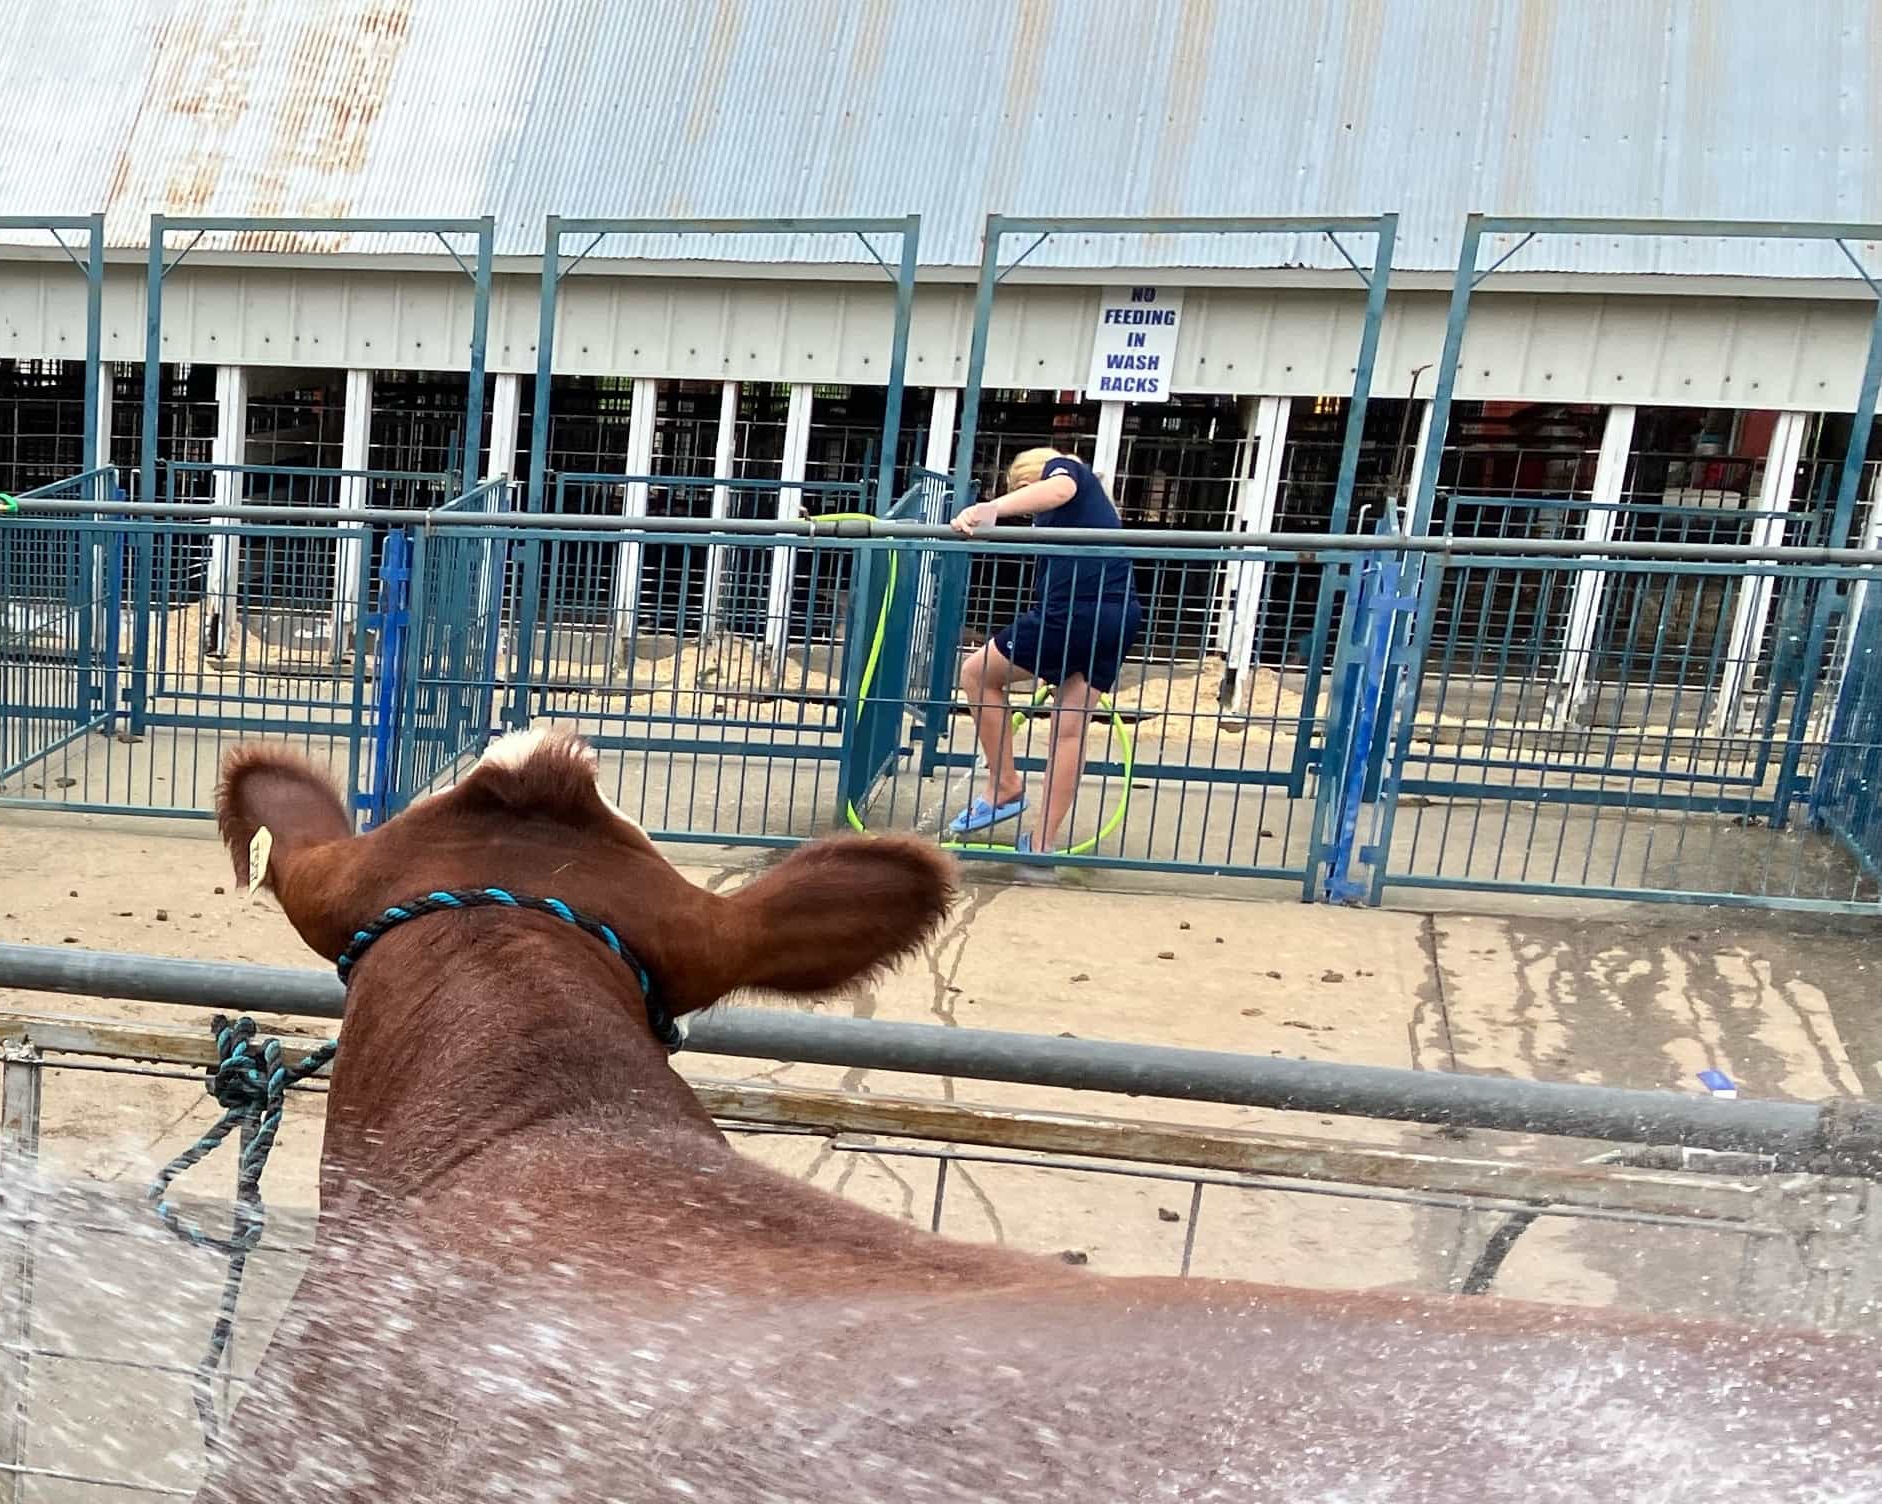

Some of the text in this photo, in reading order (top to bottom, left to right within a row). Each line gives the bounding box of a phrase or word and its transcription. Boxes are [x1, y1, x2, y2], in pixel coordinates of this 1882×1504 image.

[1131, 287, 1156, 303] NO
[1104, 309, 1175, 326] FEEDING
[1127, 332, 1146, 347] IN
[1106, 354, 1160, 370] WASH
[1099, 376, 1159, 393] RACKS
